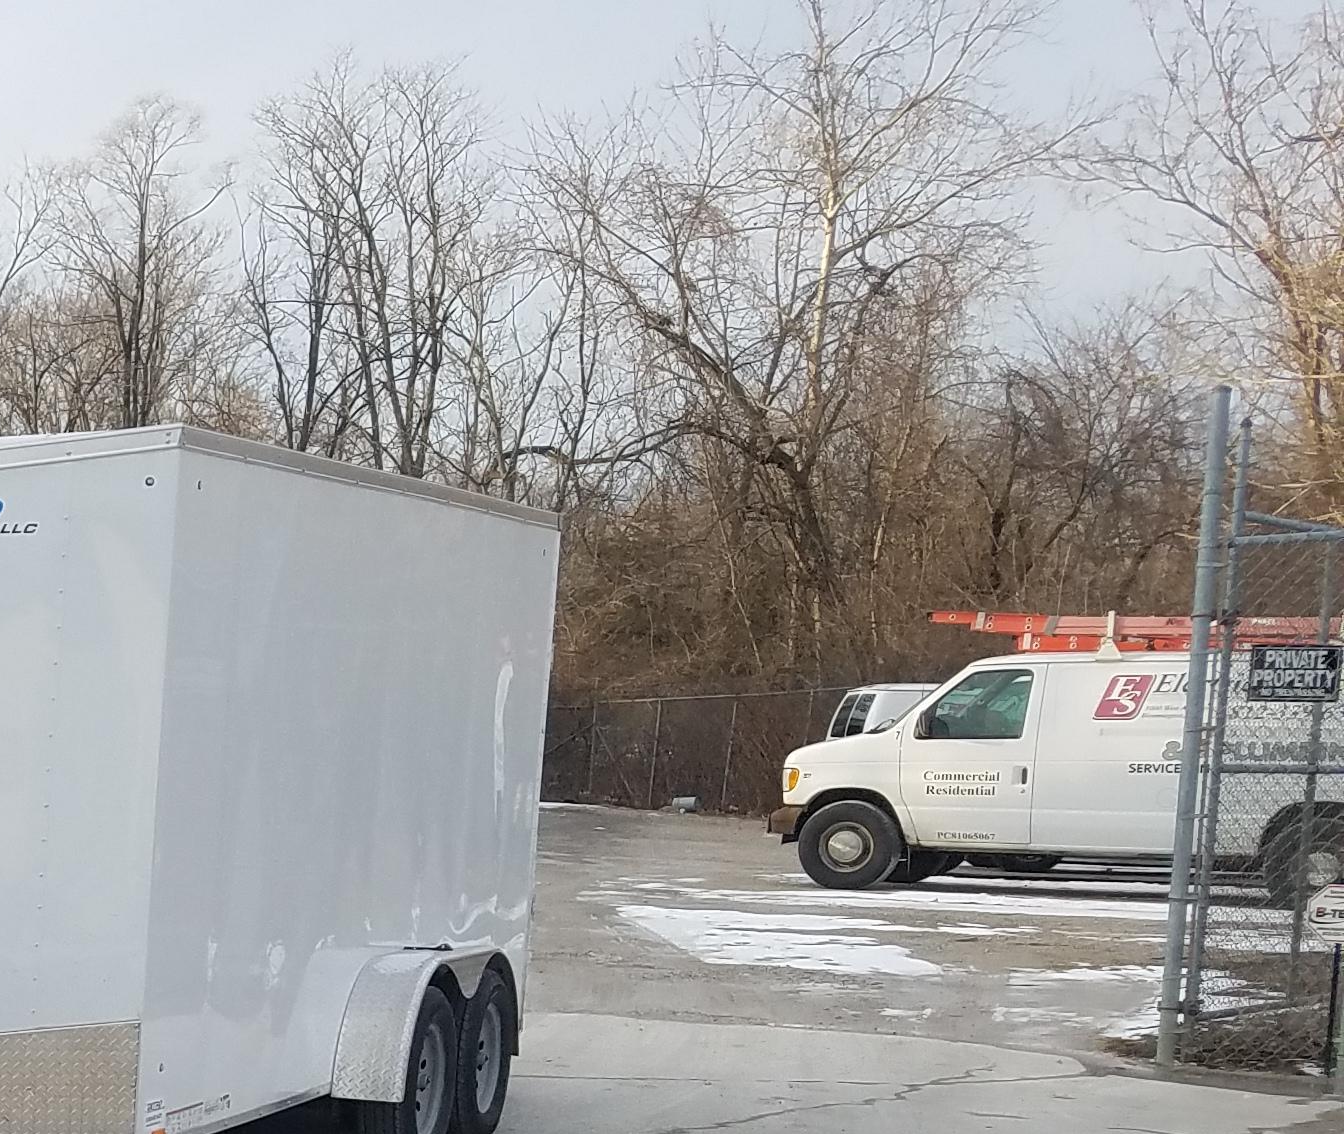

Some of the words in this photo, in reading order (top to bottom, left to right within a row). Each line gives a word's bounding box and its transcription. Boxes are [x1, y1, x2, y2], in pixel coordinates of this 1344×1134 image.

[0, 523, 39, 534] LLC
[1265, 650, 1329, 669] PRIVATE
[1251, 669, 1336, 688] PROPERTY
[923, 770, 1000, 782] Commercial
[926, 785, 996, 796] Residential
